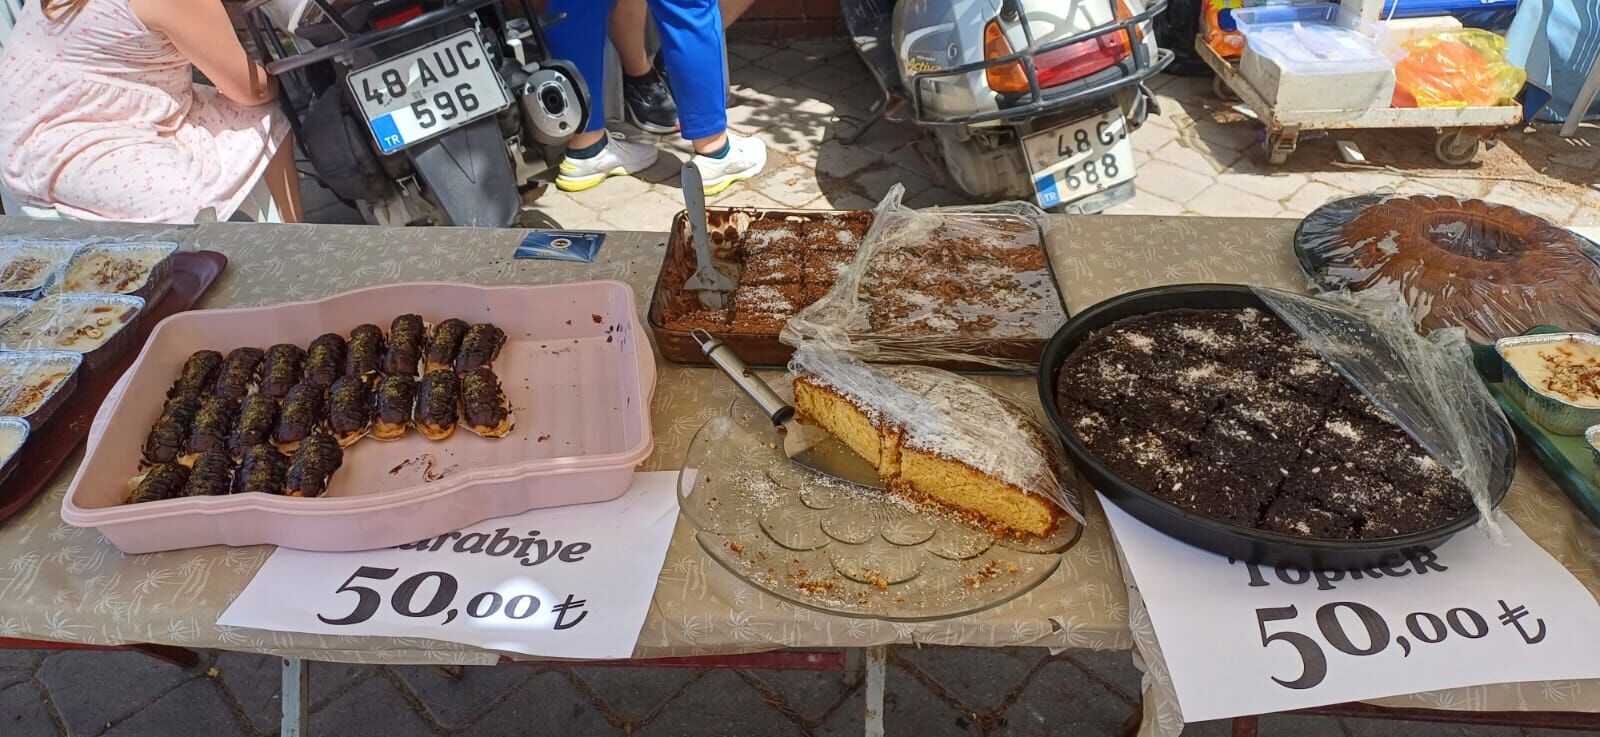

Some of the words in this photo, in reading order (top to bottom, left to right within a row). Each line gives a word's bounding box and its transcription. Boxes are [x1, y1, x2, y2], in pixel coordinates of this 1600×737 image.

[361, 68, 407, 105] 48
[416, 40, 481, 88] AUC
[410, 82, 480, 129] 596
[383, 134, 401, 148] TR
[1058, 128, 1093, 158] 48
[1064, 152, 1119, 191] 688
[1043, 191, 1057, 203] TR
[316, 565, 541, 626] 50,00
[1255, 601, 1490, 690] 50,00
